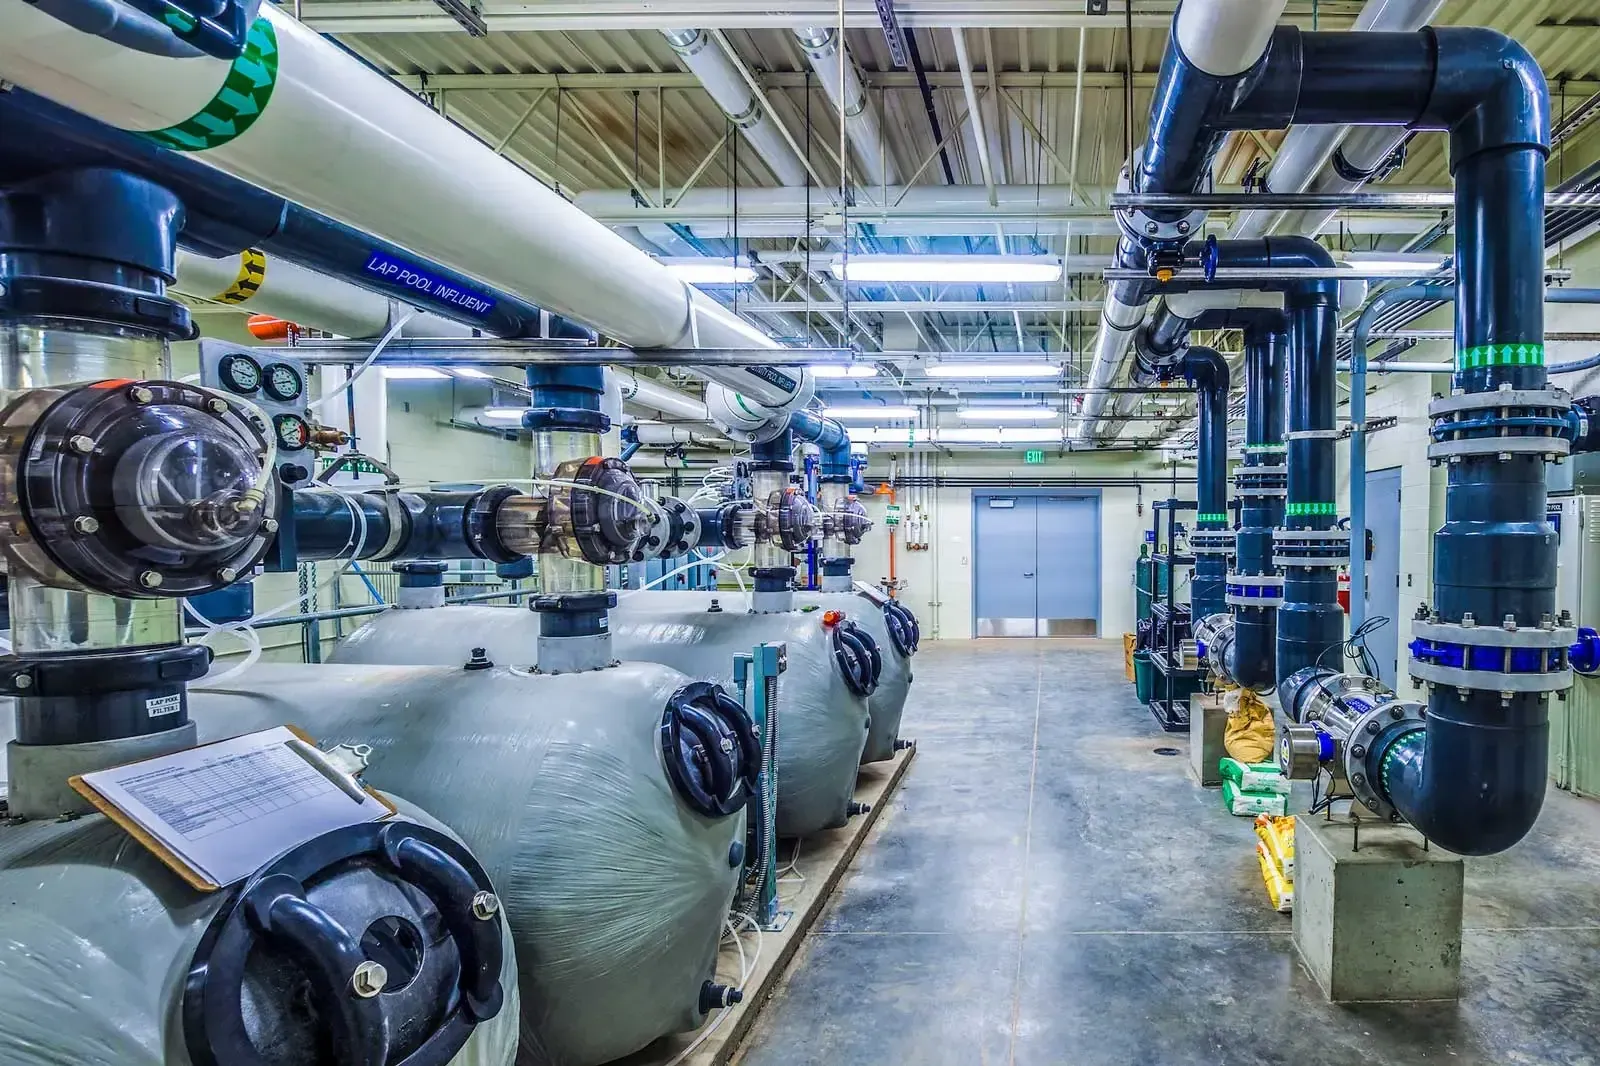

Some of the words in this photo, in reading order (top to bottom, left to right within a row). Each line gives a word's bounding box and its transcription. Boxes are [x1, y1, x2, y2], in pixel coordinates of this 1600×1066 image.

[368, 257, 398, 275] LAP
[396, 269, 433, 292] POOL
[433, 284, 492, 313] INFLUENT
[1027, 451, 1042, 463] EXIT
